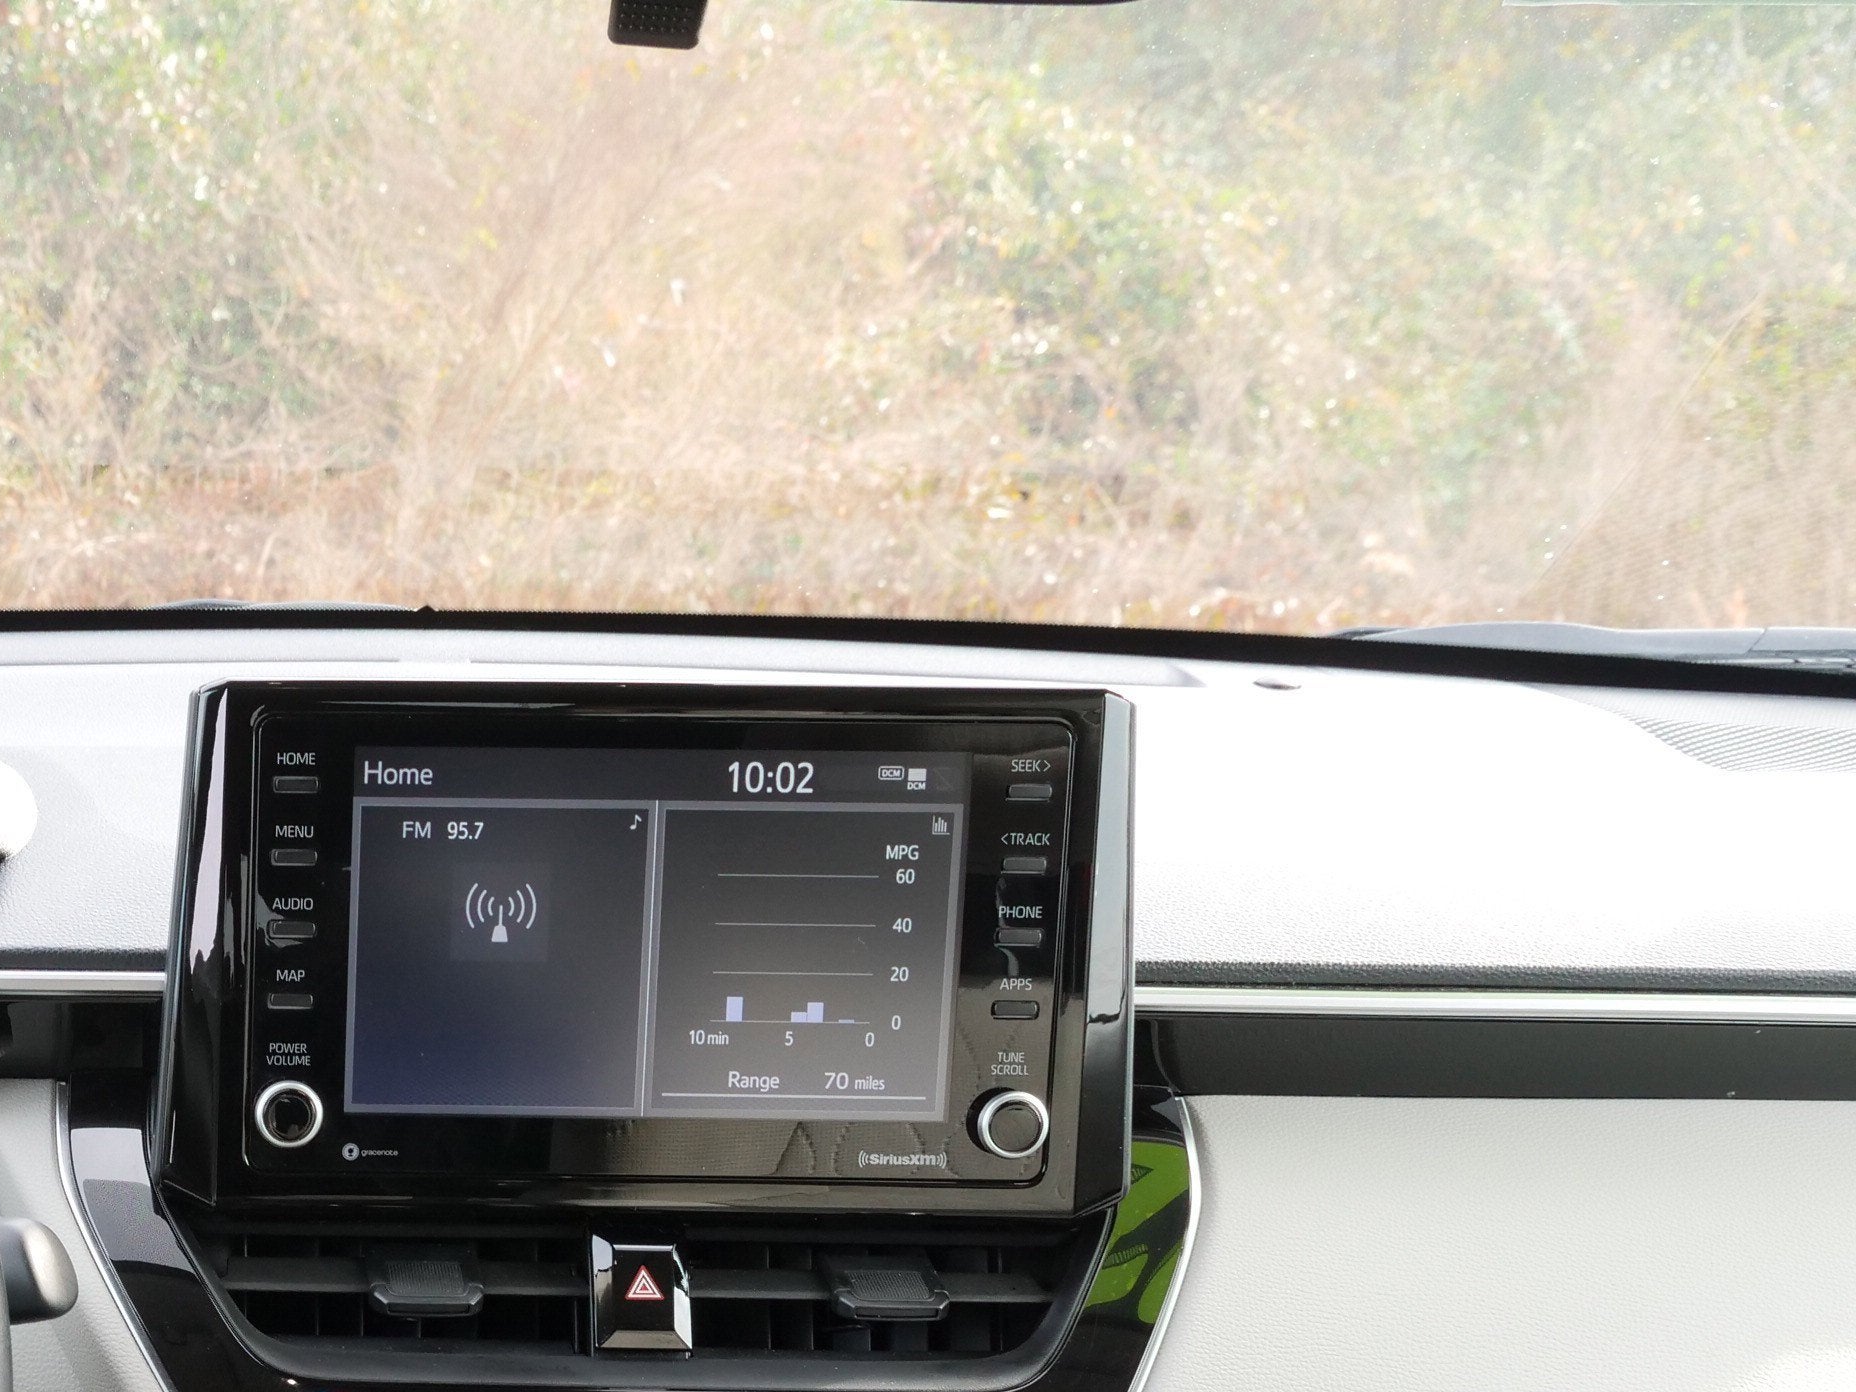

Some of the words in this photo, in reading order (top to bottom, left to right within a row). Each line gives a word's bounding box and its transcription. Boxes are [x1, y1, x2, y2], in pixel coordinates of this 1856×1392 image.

[277, 752, 316, 765] HOME
[1011, 759, 1040, 772] SEEK
[363, 760, 433, 785] Home
[728, 761, 814, 794] 10:02
[882, 769, 900, 777] DCM
[907, 782, 926, 790] DCM
[275, 825, 314, 838] MENU
[402, 821, 432, 839] FM
[447, 821, 484, 840] 95.7
[1010, 833, 1050, 846] TRACK
[885, 845, 919, 861] MPG
[896, 869, 915, 884] 60
[272, 897, 314, 911] AUDIO
[999, 906, 1043, 919] PHONE
[893, 918, 912, 933] 40
[276, 970, 305, 982] MAP
[890, 967, 909, 982] 20
[999, 978, 1032, 991] APPS
[891, 1015, 901, 1030] 0
[689, 1030, 705, 1045] 10
[707, 1032, 729, 1046] min
[785, 1031, 794, 1046] 5
[865, 1032, 874, 1047] 0
[269, 1043, 307, 1054] POWER
[266, 1055, 311, 1066] VOLUME
[997, 1052, 1025, 1063] TUNE
[991, 1064, 1029, 1076] SCROLL
[728, 1071, 780, 1090] Range
[824, 1072, 848, 1090] 70
[855, 1077, 885, 1091] miles
